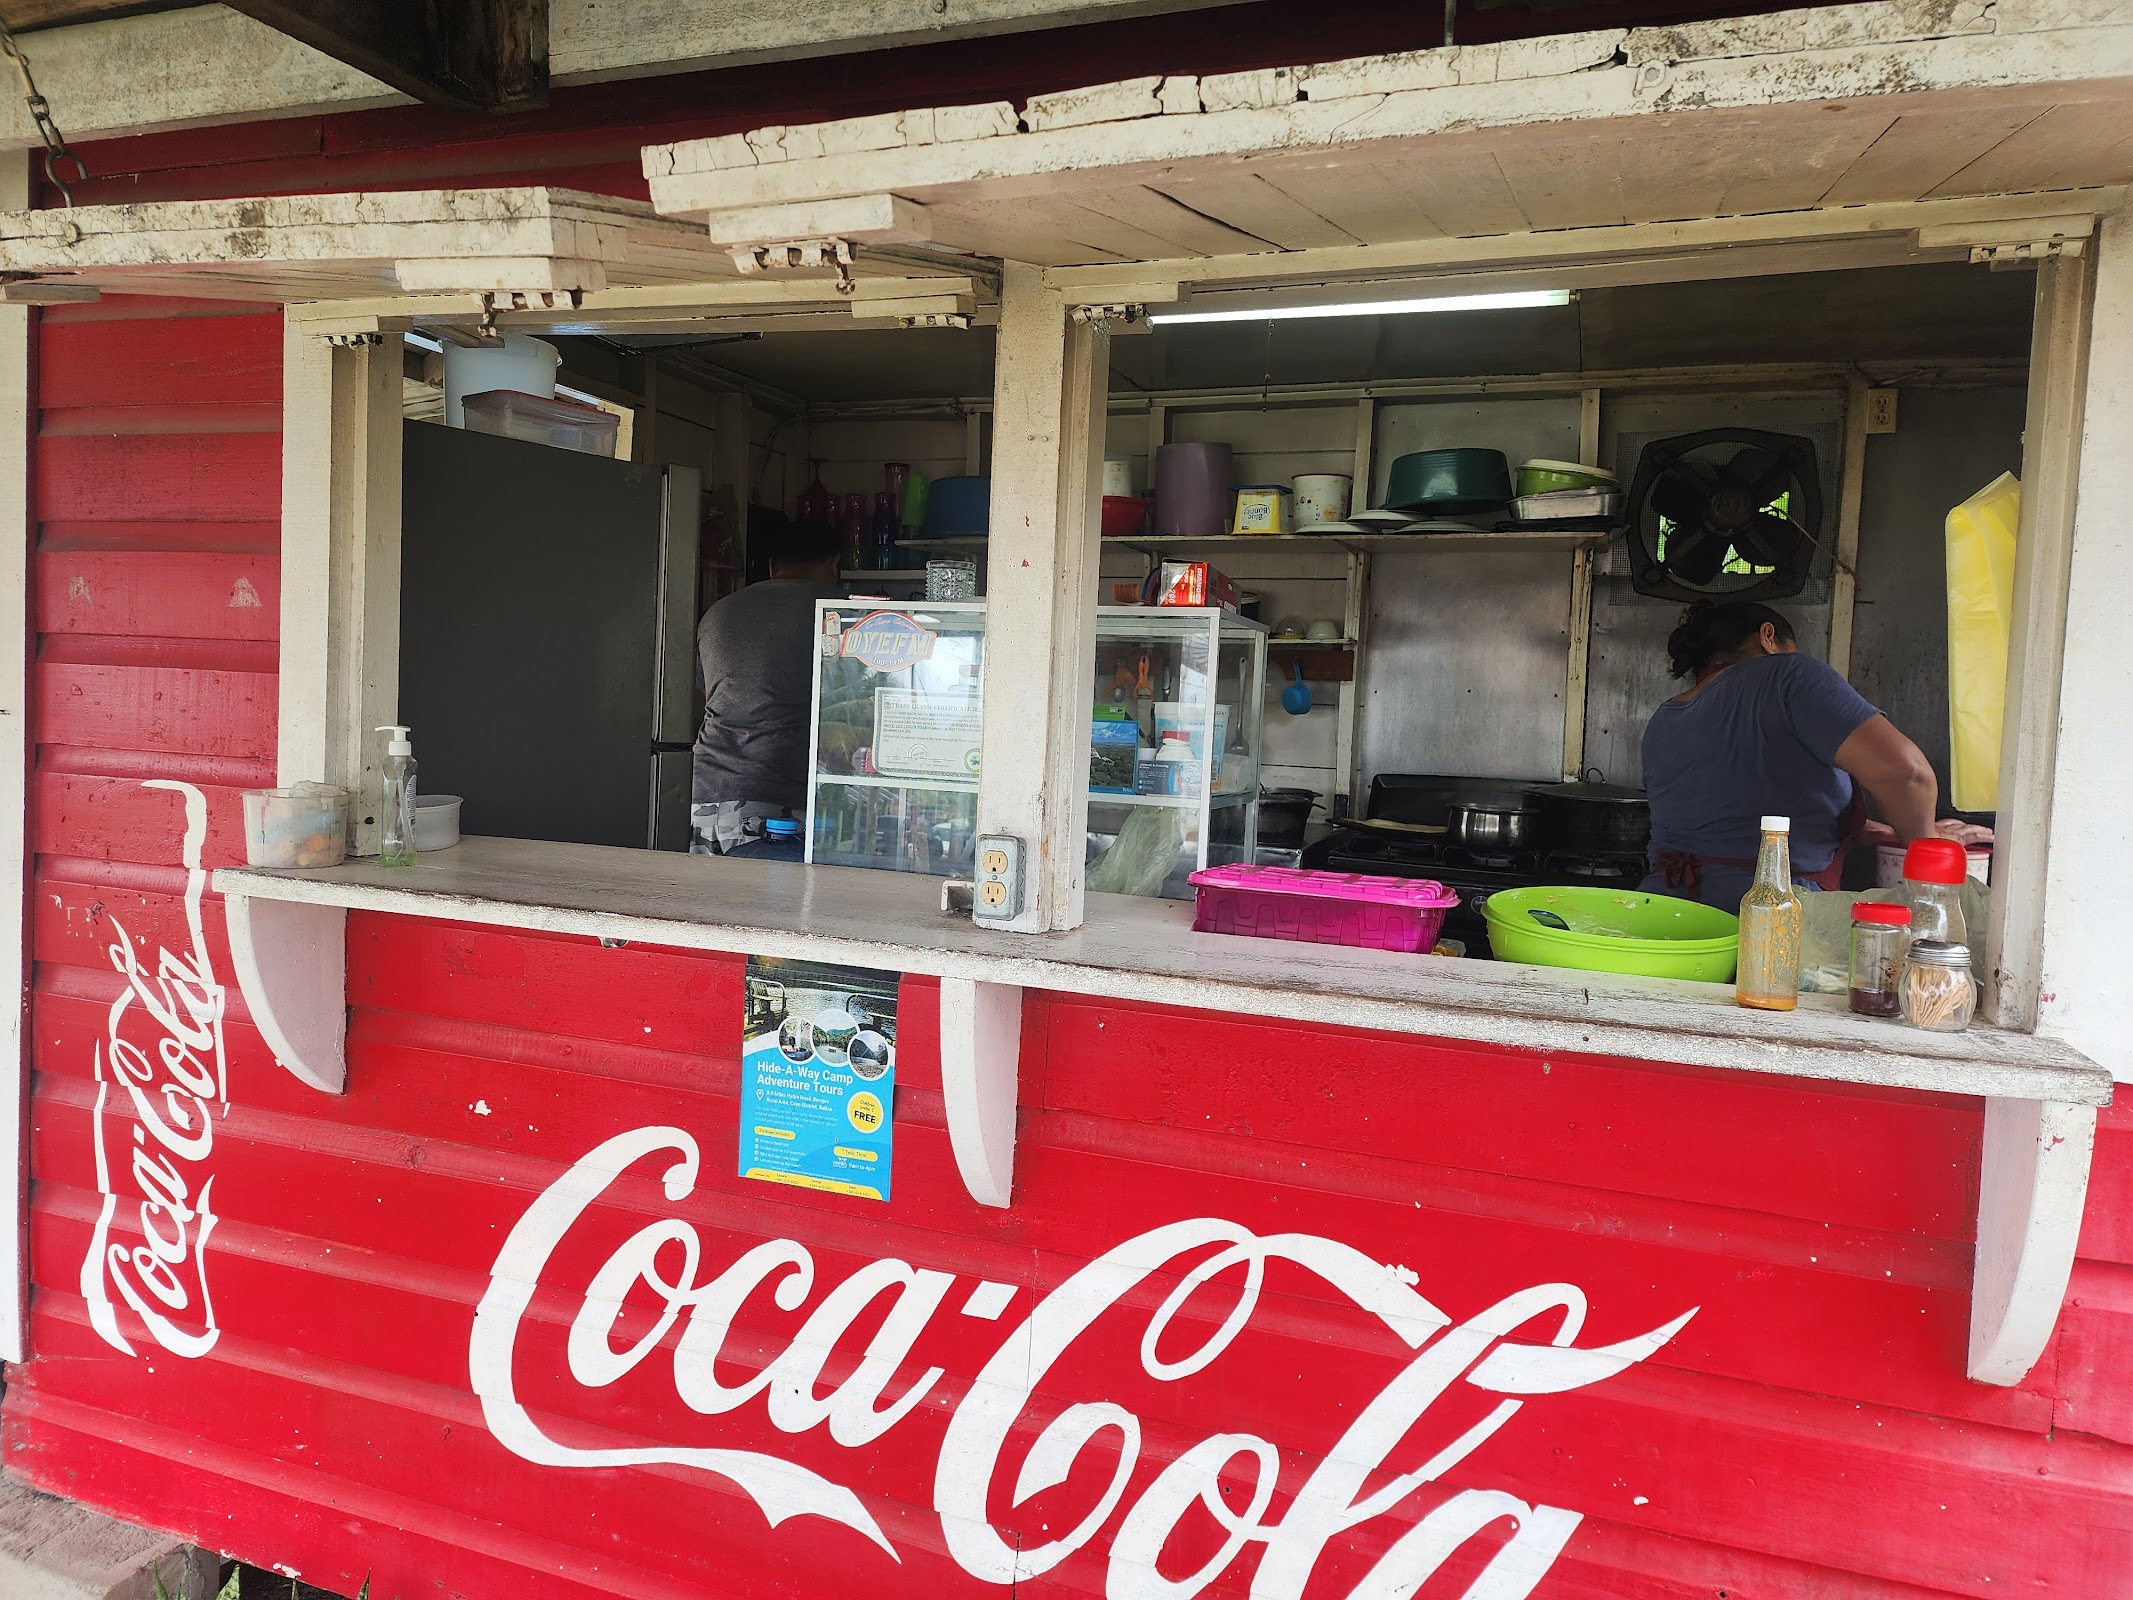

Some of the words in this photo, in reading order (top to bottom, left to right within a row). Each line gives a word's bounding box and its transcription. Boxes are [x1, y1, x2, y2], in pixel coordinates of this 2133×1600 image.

[1248, 513, 1263, 521] Blue
[1195, 567, 1203, 605] DIAMOND
[1168, 588, 1176, 604] 200
[757, 1061, 820, 1081] Hide-A-Way
[822, 1072, 853, 1086] Camp
[757, 1074, 810, 1091] Adventure
[814, 1081, 843, 1096] Tours
[790, 1100, 801, 1108] Cayo
[854, 1110, 876, 1124] FREE
[108, 914, 224, 1359] Coca-Cola
